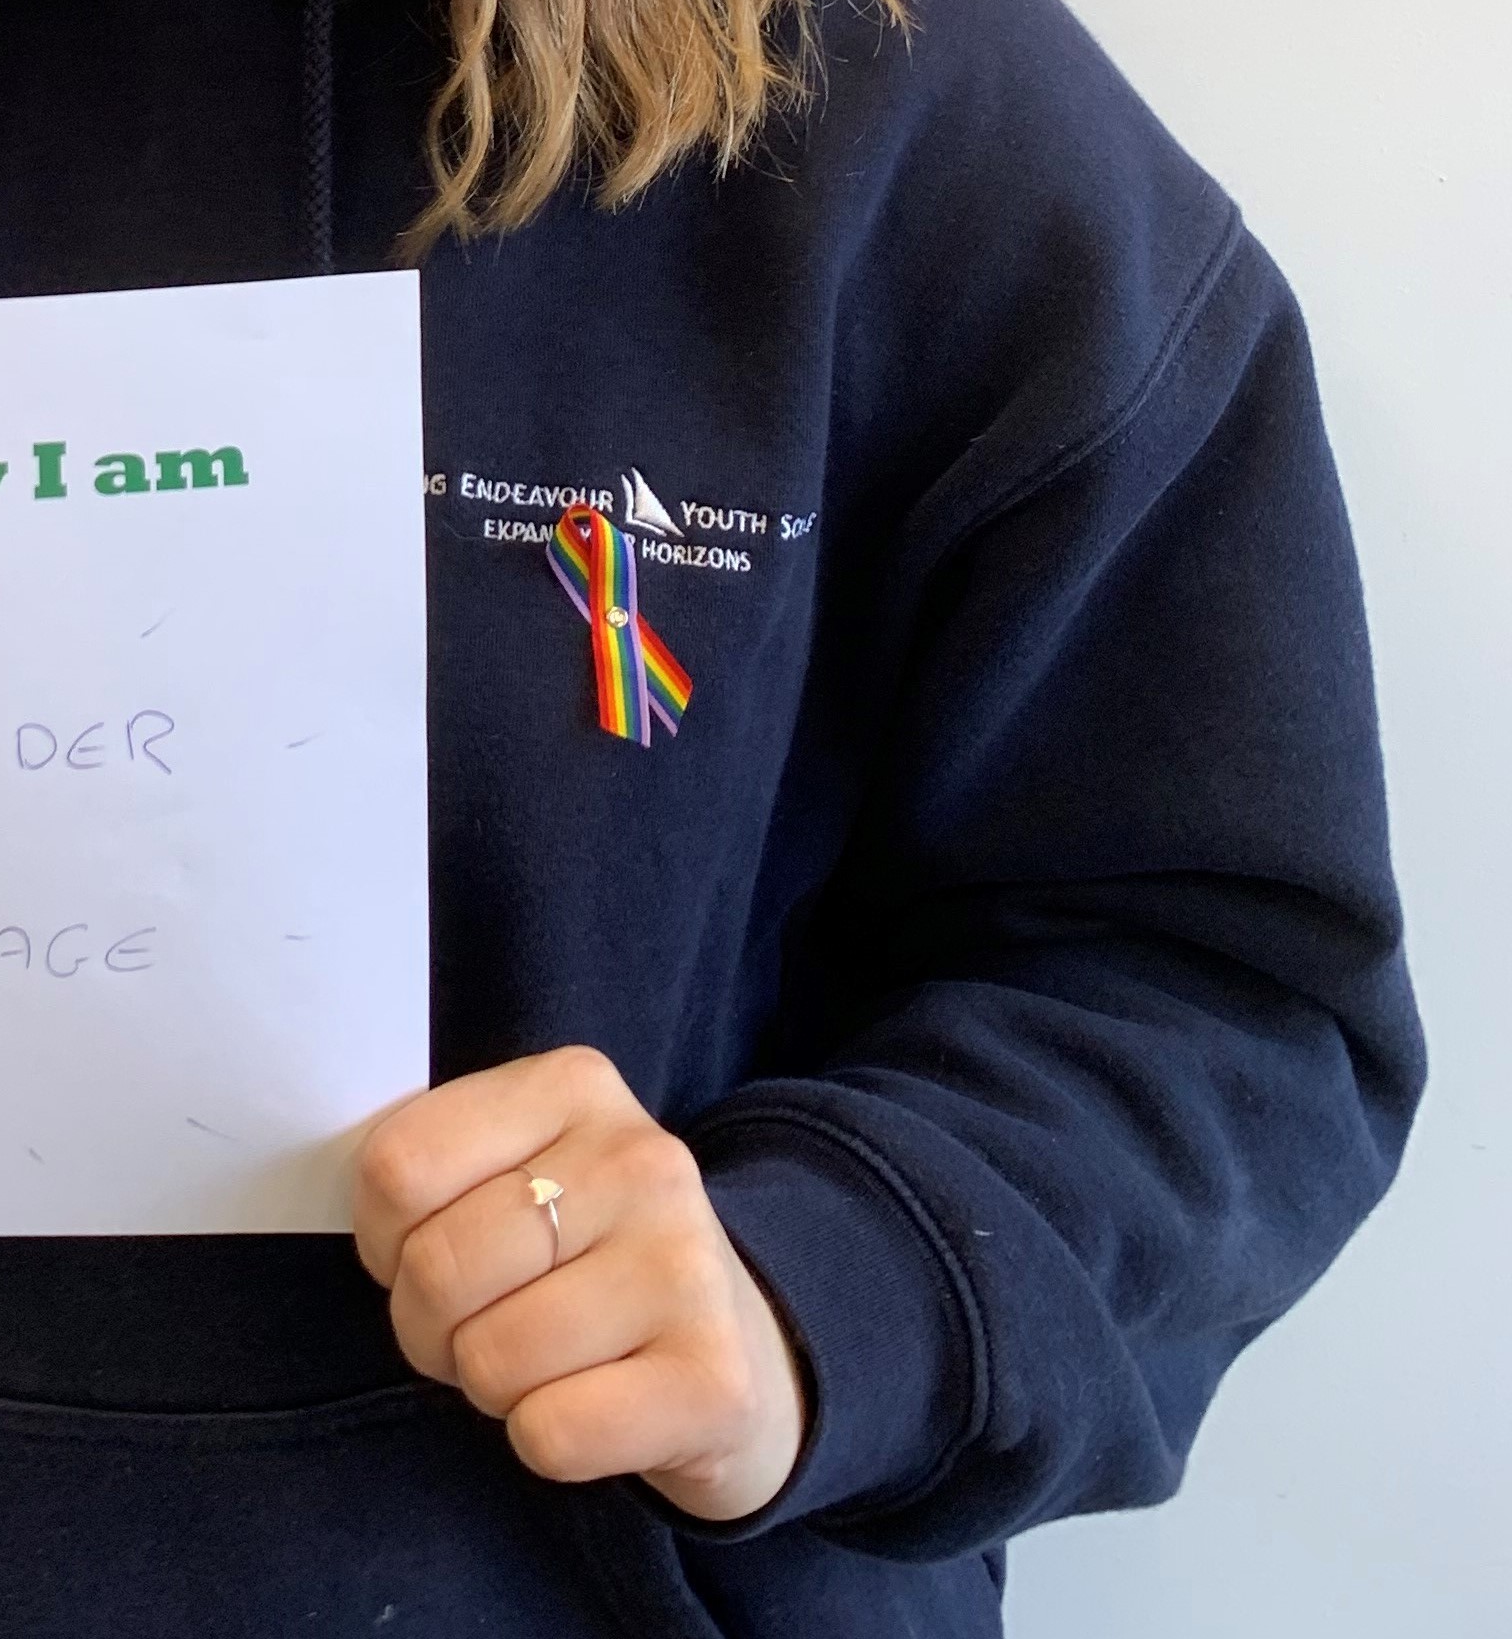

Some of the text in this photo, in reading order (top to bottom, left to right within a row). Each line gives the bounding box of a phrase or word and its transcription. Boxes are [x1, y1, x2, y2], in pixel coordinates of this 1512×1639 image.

[33, 441, 68, 500] I
[93, 445, 250, 497] am
[460, 472, 615, 513] ENDEAVOUR
[679, 499, 768, 535] YOUTH
[641, 537, 752, 572] HORIZONS
